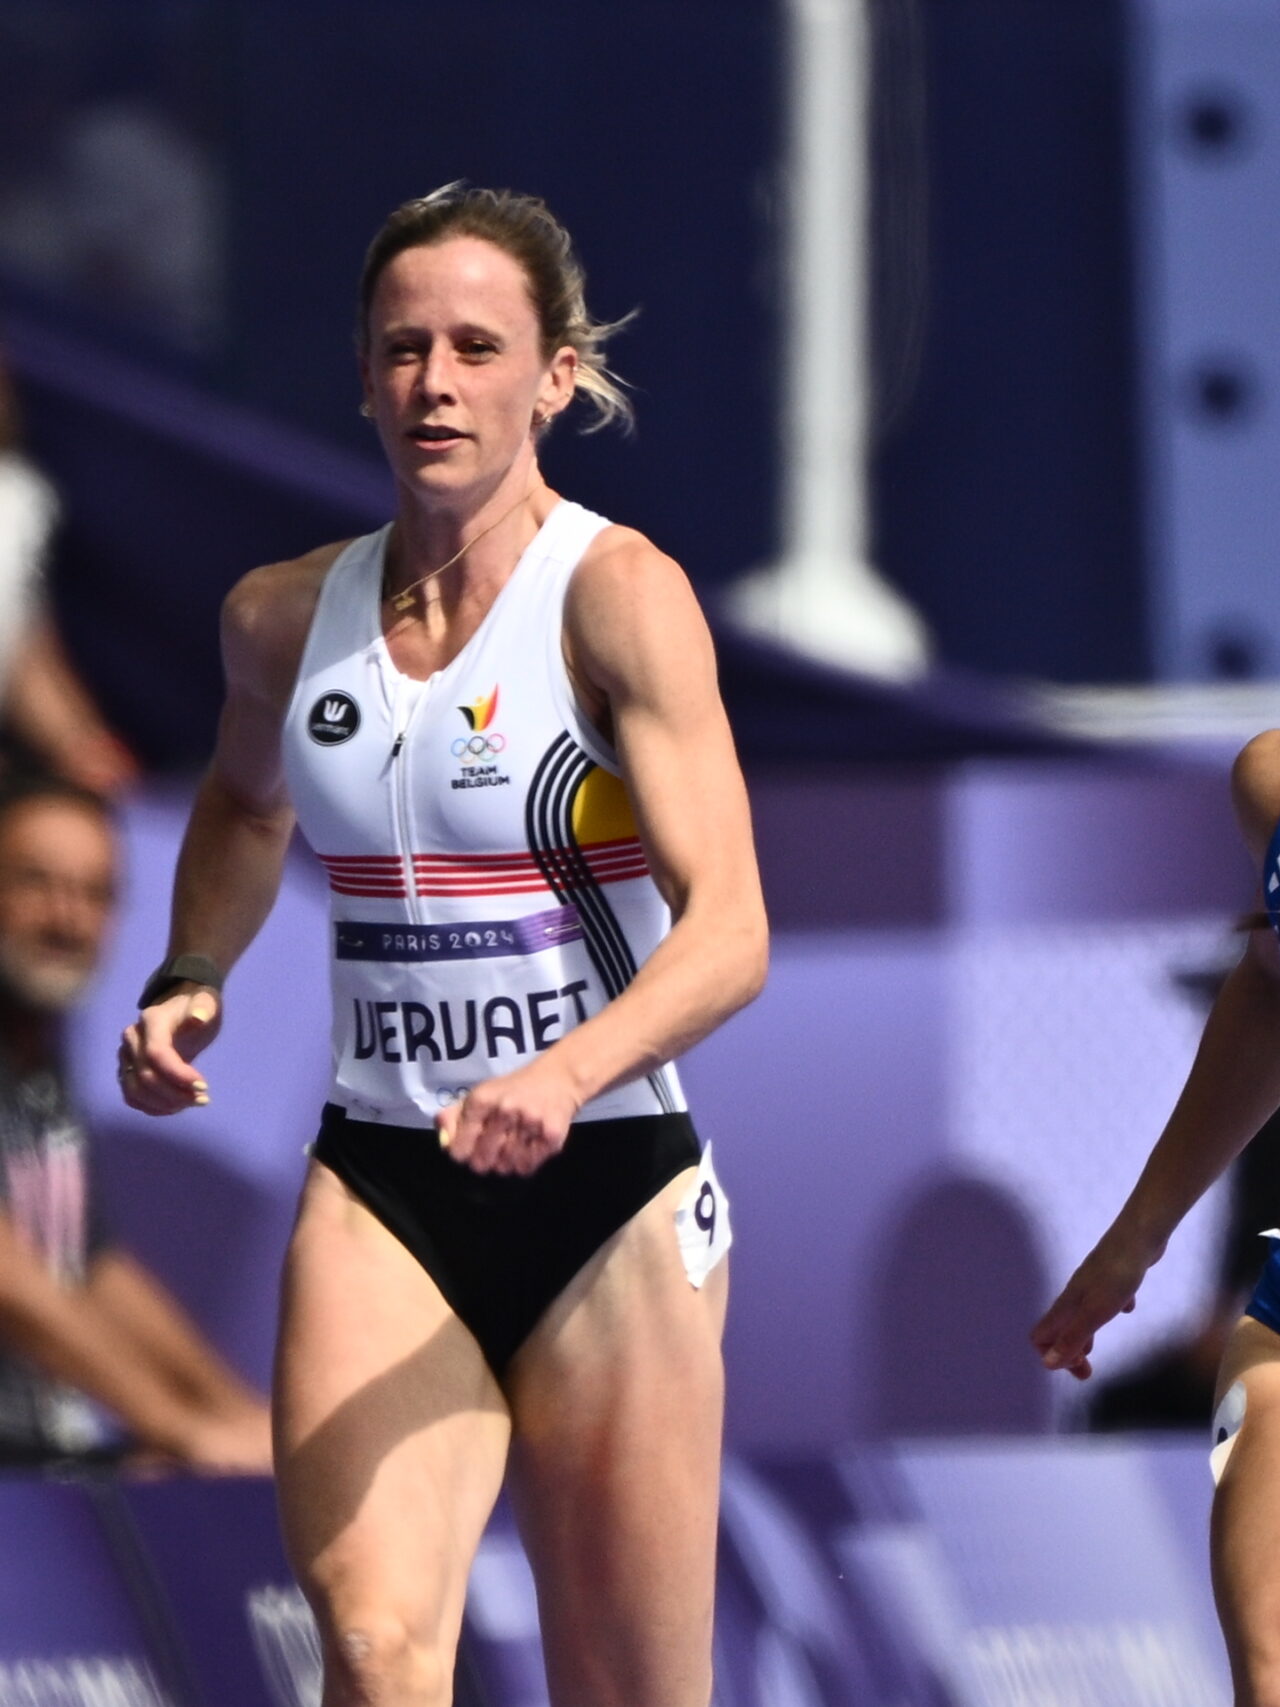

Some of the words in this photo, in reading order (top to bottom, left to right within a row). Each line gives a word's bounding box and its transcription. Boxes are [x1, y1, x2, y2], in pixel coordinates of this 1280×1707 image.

[461, 765, 497, 777] TEAM
[451, 775, 510, 790] BELGIUM
[382, 933, 441, 950] PARIS
[449, 930, 515, 949] 2024
[353, 979, 588, 1062] VERVAET
[695, 1180, 716, 1247] 9
